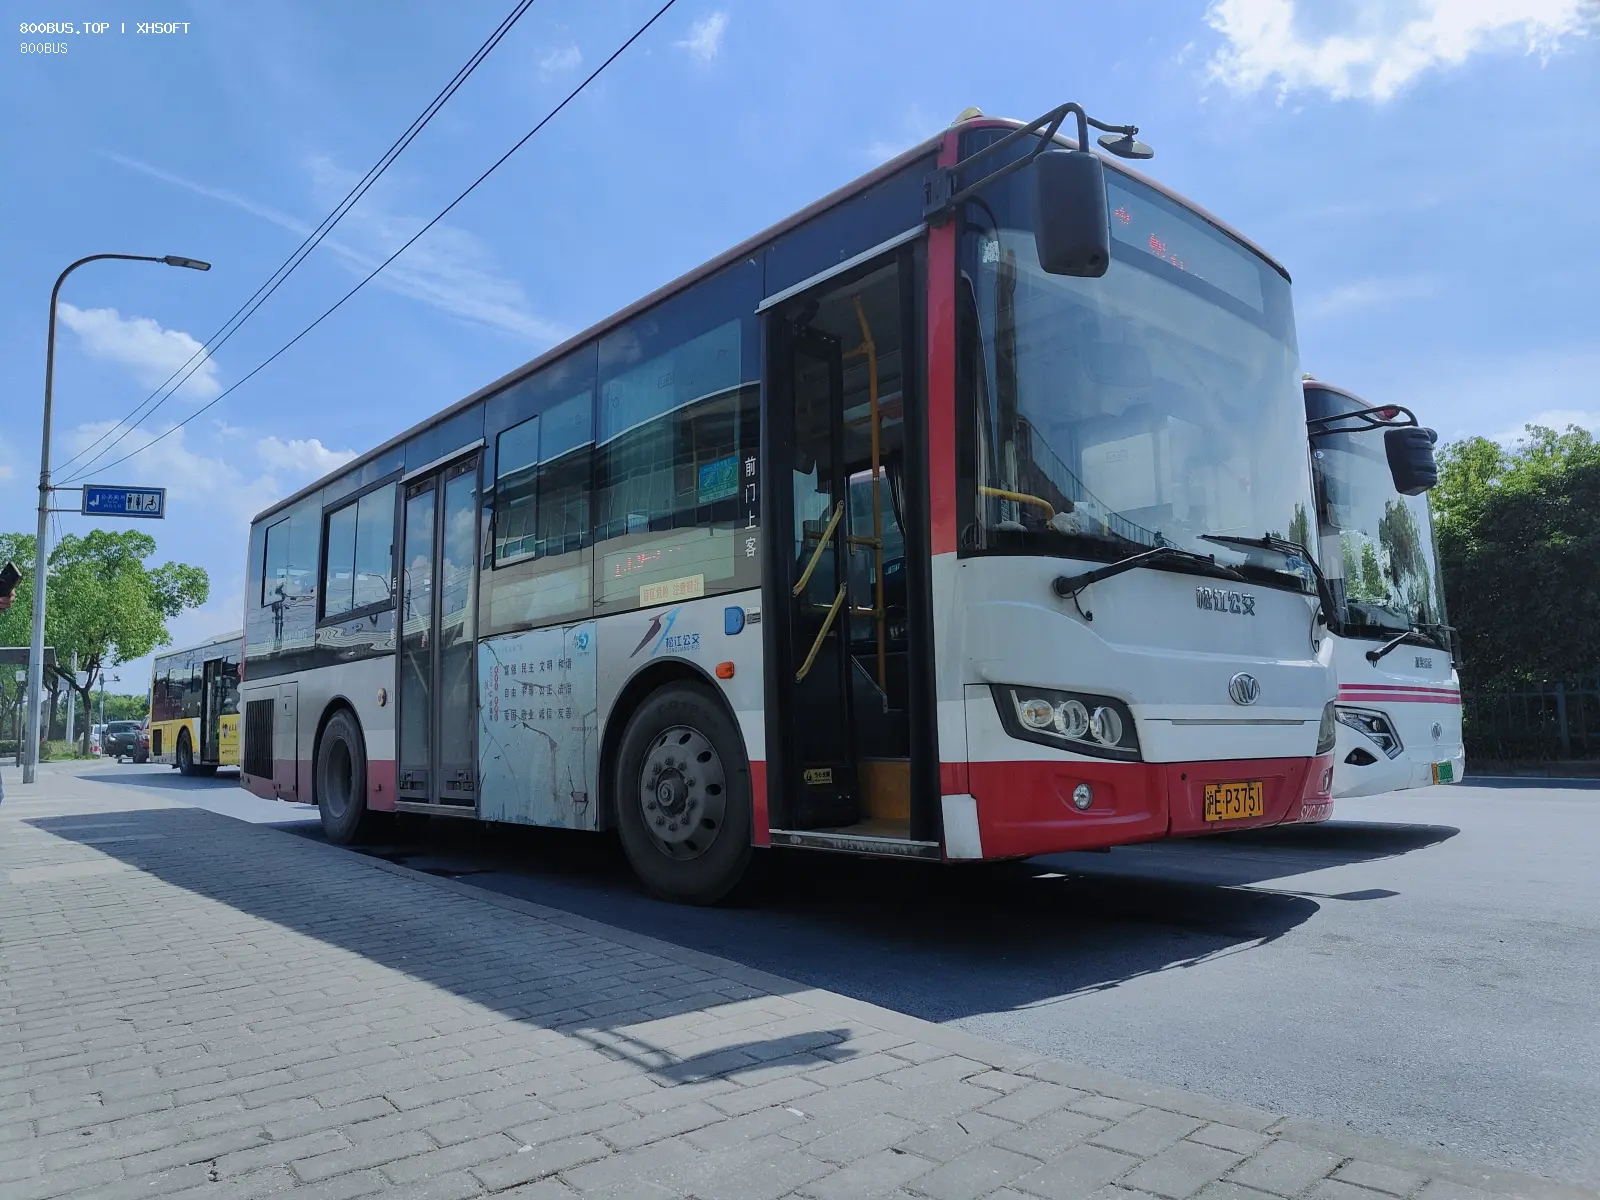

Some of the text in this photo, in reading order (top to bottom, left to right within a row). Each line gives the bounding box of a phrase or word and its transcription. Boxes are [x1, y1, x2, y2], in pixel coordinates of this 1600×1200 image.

[744, 456, 757, 558] 前门上客
[1195, 585, 1256, 617] 松江公交
[665, 633, 700, 648] 松江公交
[521, 661, 535, 674] 民主
[539, 659, 553, 672] 文明
[504, 686, 517, 698] 自由
